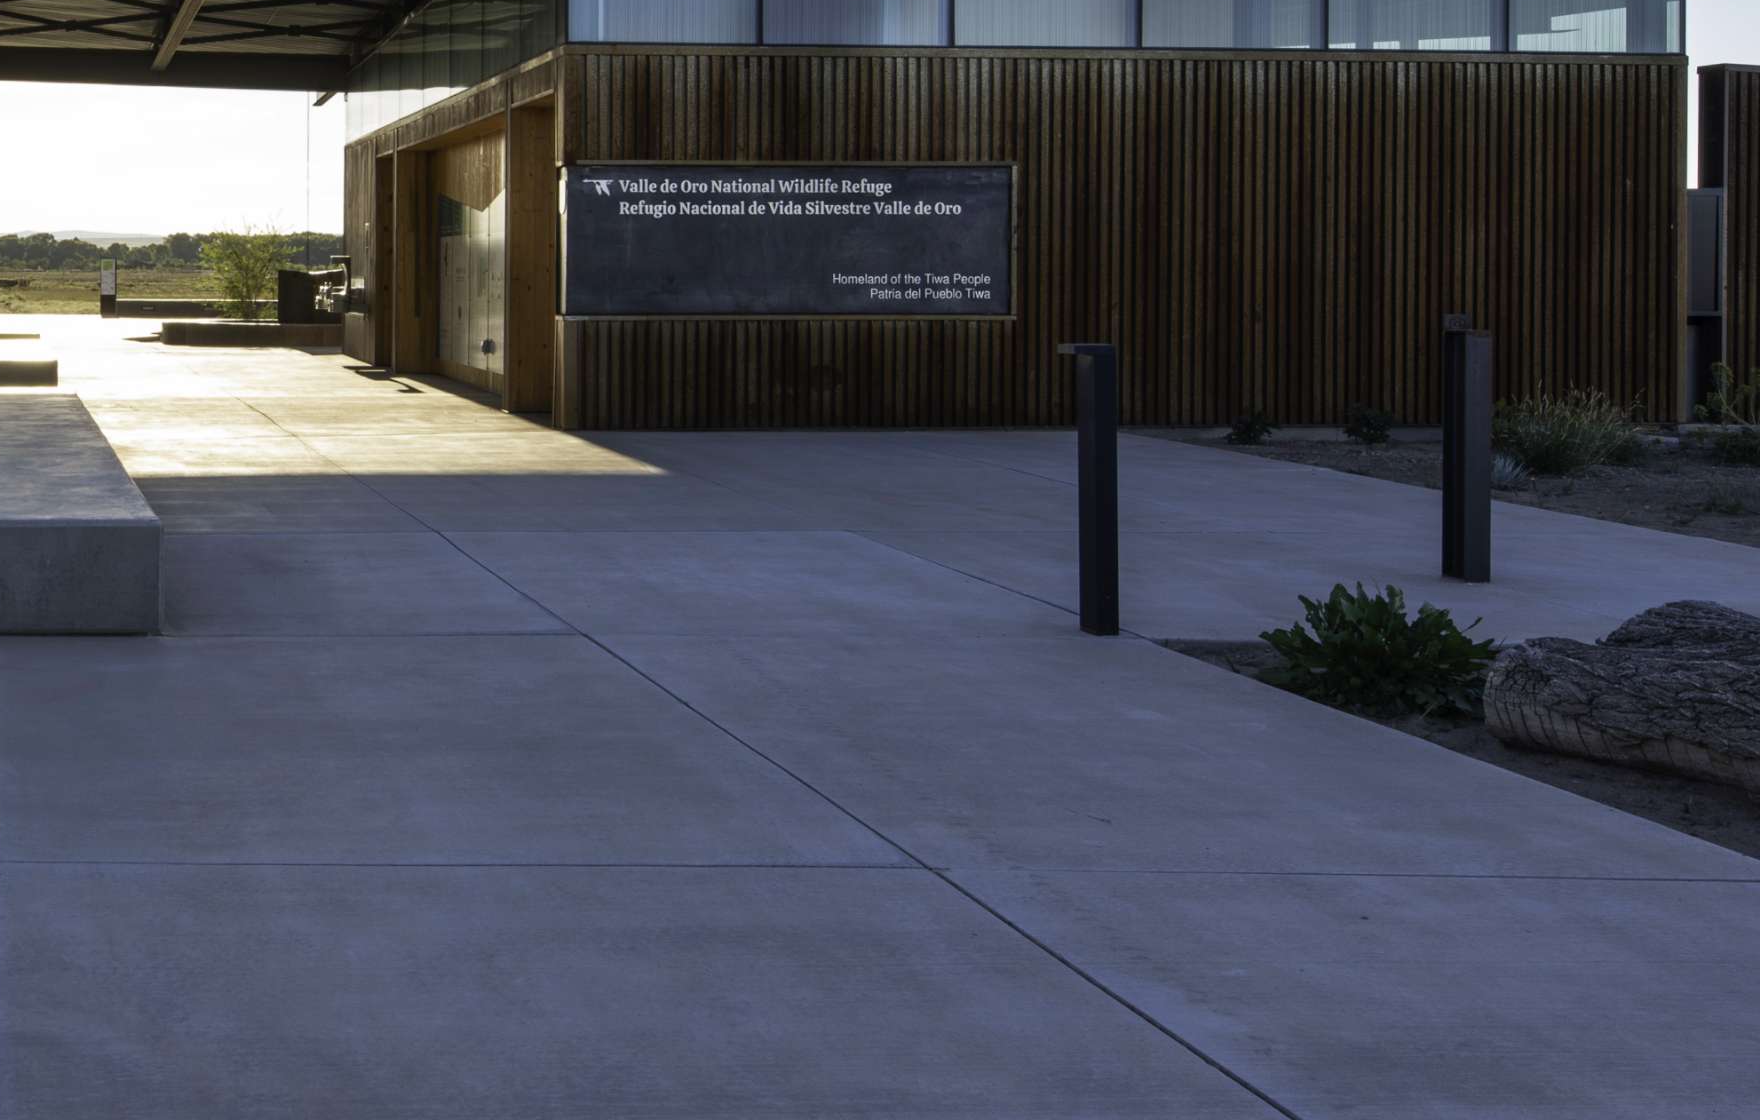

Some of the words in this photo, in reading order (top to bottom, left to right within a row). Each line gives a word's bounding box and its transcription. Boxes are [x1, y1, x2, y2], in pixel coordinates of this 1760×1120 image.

[619, 178, 657, 193] Valle
[659, 178, 678, 193] de
[680, 180, 708, 193] Oro
[711, 178, 775, 193] National
[778, 178, 839, 193] Wildlife
[841, 178, 892, 197] Refuge
[619, 200, 676, 219] Refugio
[679, 200, 745, 215] Nacional
[748, 200, 766, 215] de
[768, 200, 802, 215] Vida
[805, 200, 871, 215] Silvestre
[873, 200, 911, 215] Valle
[914, 200, 932, 215] de
[934, 201, 962, 215] Oro
[832, 273, 888, 284] Homeland
[890, 273, 902, 284] of
[904, 273, 921, 284] the
[924, 273, 950, 284] Tiwa
[953, 273, 991, 286] People
[870, 288, 902, 299] Patria
[904, 288, 921, 299] del
[924, 288, 962, 299] Pueblo
[965, 288, 991, 299] Tiwa
